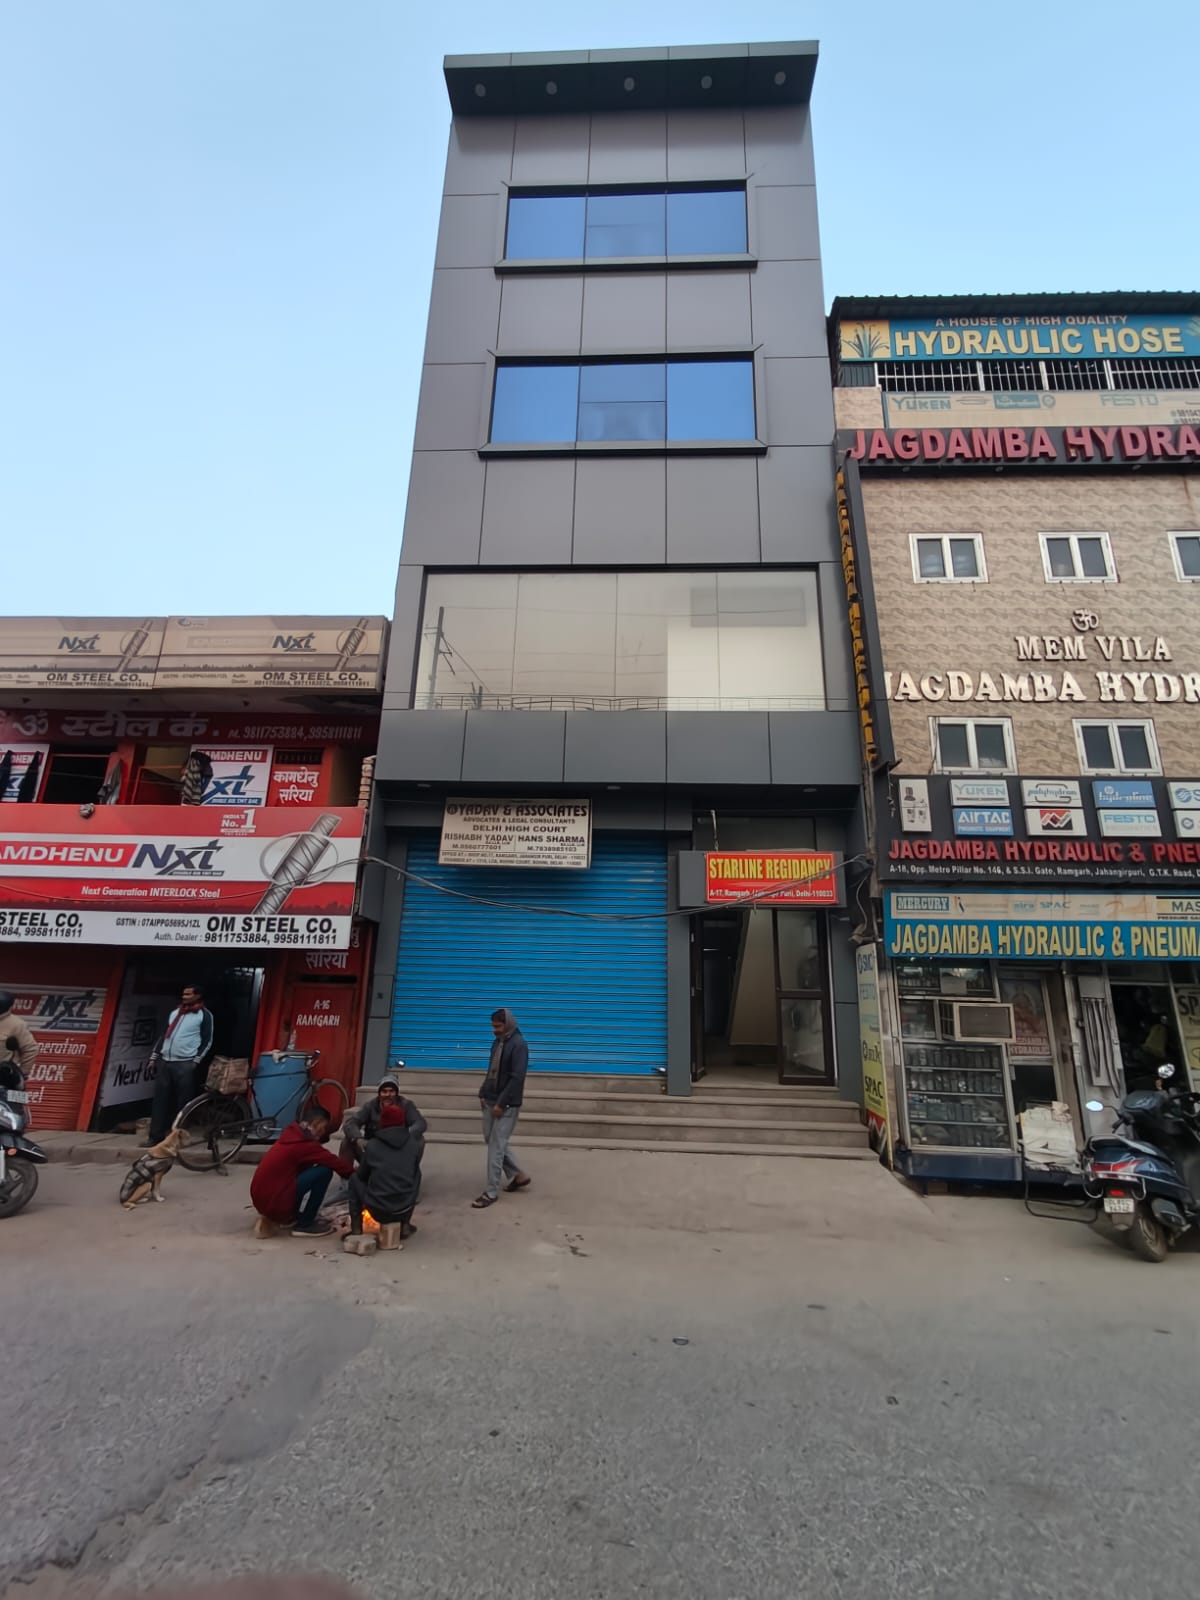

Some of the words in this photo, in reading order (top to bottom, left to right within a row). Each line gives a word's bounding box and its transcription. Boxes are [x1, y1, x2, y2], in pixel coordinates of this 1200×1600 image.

[936, 318, 944, 327] A
[950, 317, 998, 327] HOUSE
[1002, 316, 1019, 326] OF
[1026, 316, 1060, 326] HIGH
[1066, 315, 1128, 325] QUALITY
[894, 329, 1084, 356] HYDRAULIC
[1093, 327, 1185, 353] HOSE
[849, 425, 1058, 460] JAGDAMBA
[1016, 636, 1088, 661] MEM
[1095, 635, 1174, 661] VILA
[47, 672, 68, 681] OM
[72, 672, 115, 682] STEEL
[119, 673, 142, 682] CO.
[263, 672, 285, 681] OM
[289, 672, 333, 681] STEEL
[338, 672, 363, 682] CO.
[459, 804, 500, 817] YADAV
[503, 805, 512, 816] &
[516, 805, 588, 817] ASSOCIATES
[221, 819, 239, 828] No.
[241, 808, 257, 829] 1
[505, 825, 530, 833] HIGH
[444, 833, 483, 841] RISHABH
[485, 834, 514, 842] YADAV
[518, 835, 543, 843] HANS
[888, 839, 999, 861] JAGDAMBA
[1005, 840, 1123, 862] HYDRAULIC
[1130, 842, 1146, 862] &
[709, 858, 763, 879] STARLINE
[766, 858, 831, 880] REGIDANCY
[81, 885, 101, 896] Next
[102, 886, 148, 897] Generation
[150, 887, 198, 898] INTERLOCK
[200, 888, 220, 898] Steel
[897, 896, 949, 910] MERCURY
[55, 913, 83, 928] CO.
[206, 916, 236, 932] OM
[241, 917, 300, 934] STEEL
[306, 918, 338, 934] CO.
[25, 926, 82, 938] 9958111811
[154, 931, 172, 941] Auth.
[174, 932, 198, 942] Dealer
[204, 932, 271, 945] 9811753884,
[273, 934, 337, 945] 9958111811
[891, 924, 993, 954] JAGDAMBA
[997, 925, 1105, 956] HYDRAULIC
[1111, 925, 1125, 957] &
[296, 1014, 341, 1027] RAMGARH
[113, 1063, 141, 1087] Next
